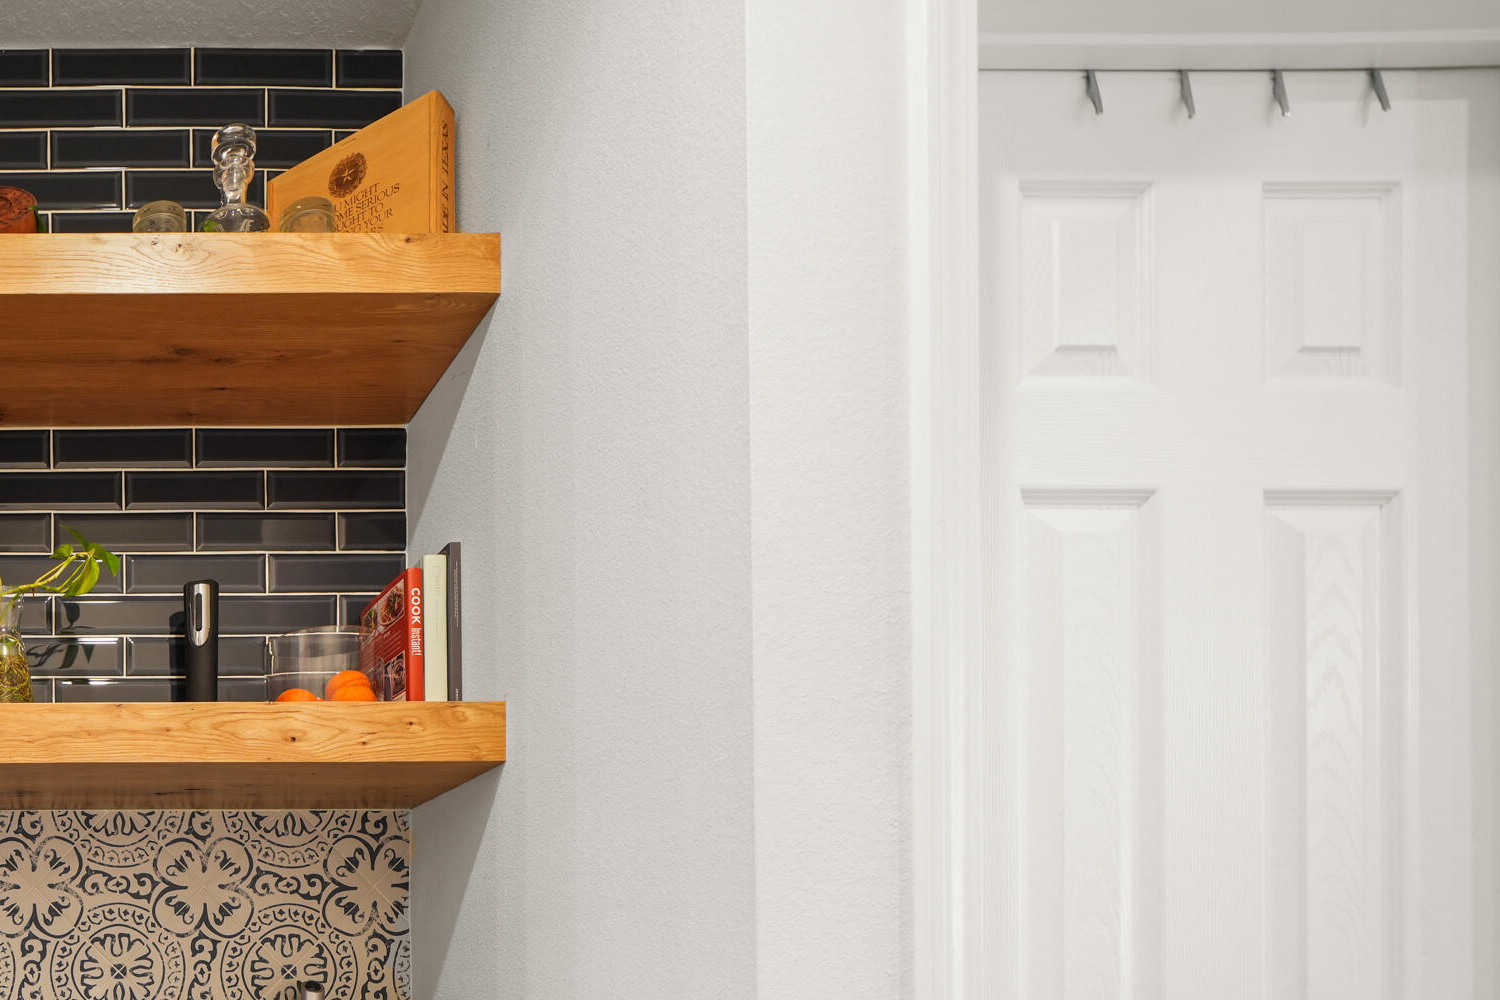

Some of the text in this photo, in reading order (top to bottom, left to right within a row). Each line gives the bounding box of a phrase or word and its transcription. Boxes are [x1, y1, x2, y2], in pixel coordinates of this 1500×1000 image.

[441, 120, 449, 174] TEXAS
[344, 182, 380, 207] MIGHT
[355, 183, 400, 213] SERIOUS
[363, 208, 393, 230] YOUR
[368, 202, 384, 216] TO
[411, 587, 422, 656] COOK Instant!
